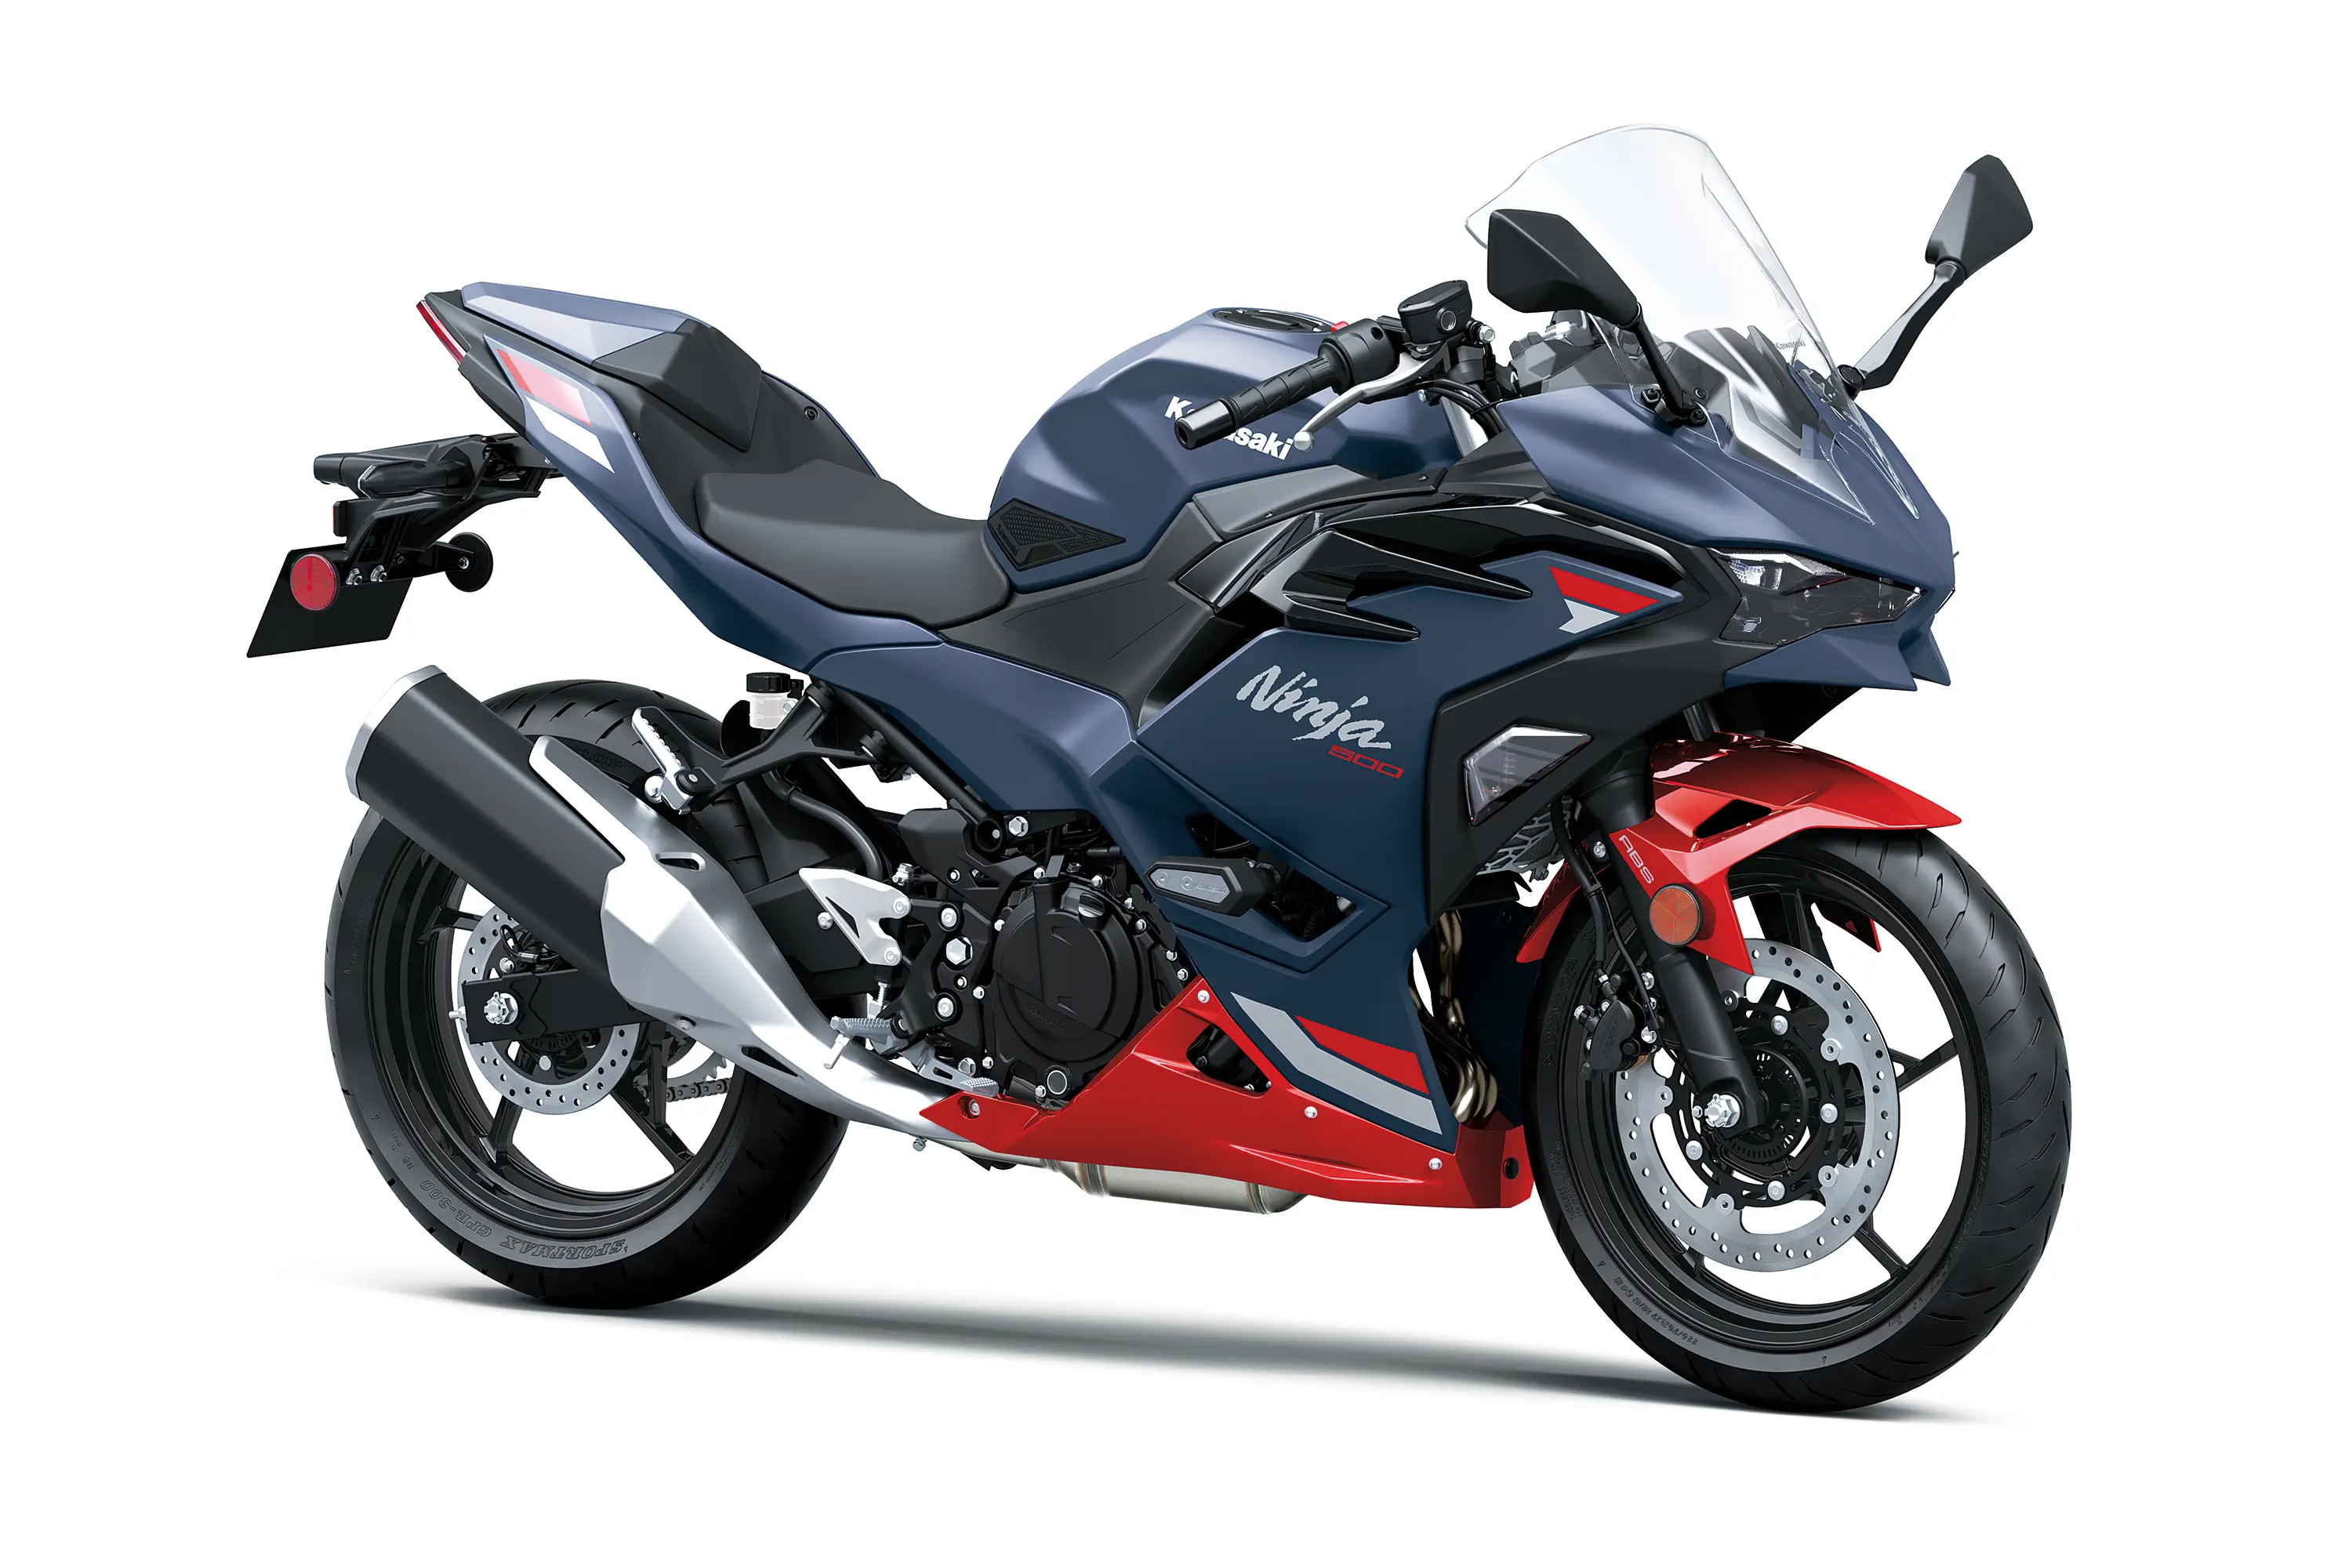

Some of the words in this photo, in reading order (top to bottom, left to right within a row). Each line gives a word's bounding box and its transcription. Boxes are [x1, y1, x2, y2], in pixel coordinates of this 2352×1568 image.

[1164, 395, 1294, 460] Ksaki
[1236, 665, 1392, 750] Ninja
[1328, 745, 1404, 779] 500
[1619, 835, 1654, 884] ABS
[419, 1179, 493, 1238] GPR-300
[499, 1236, 626, 1260] SPORTMAX
